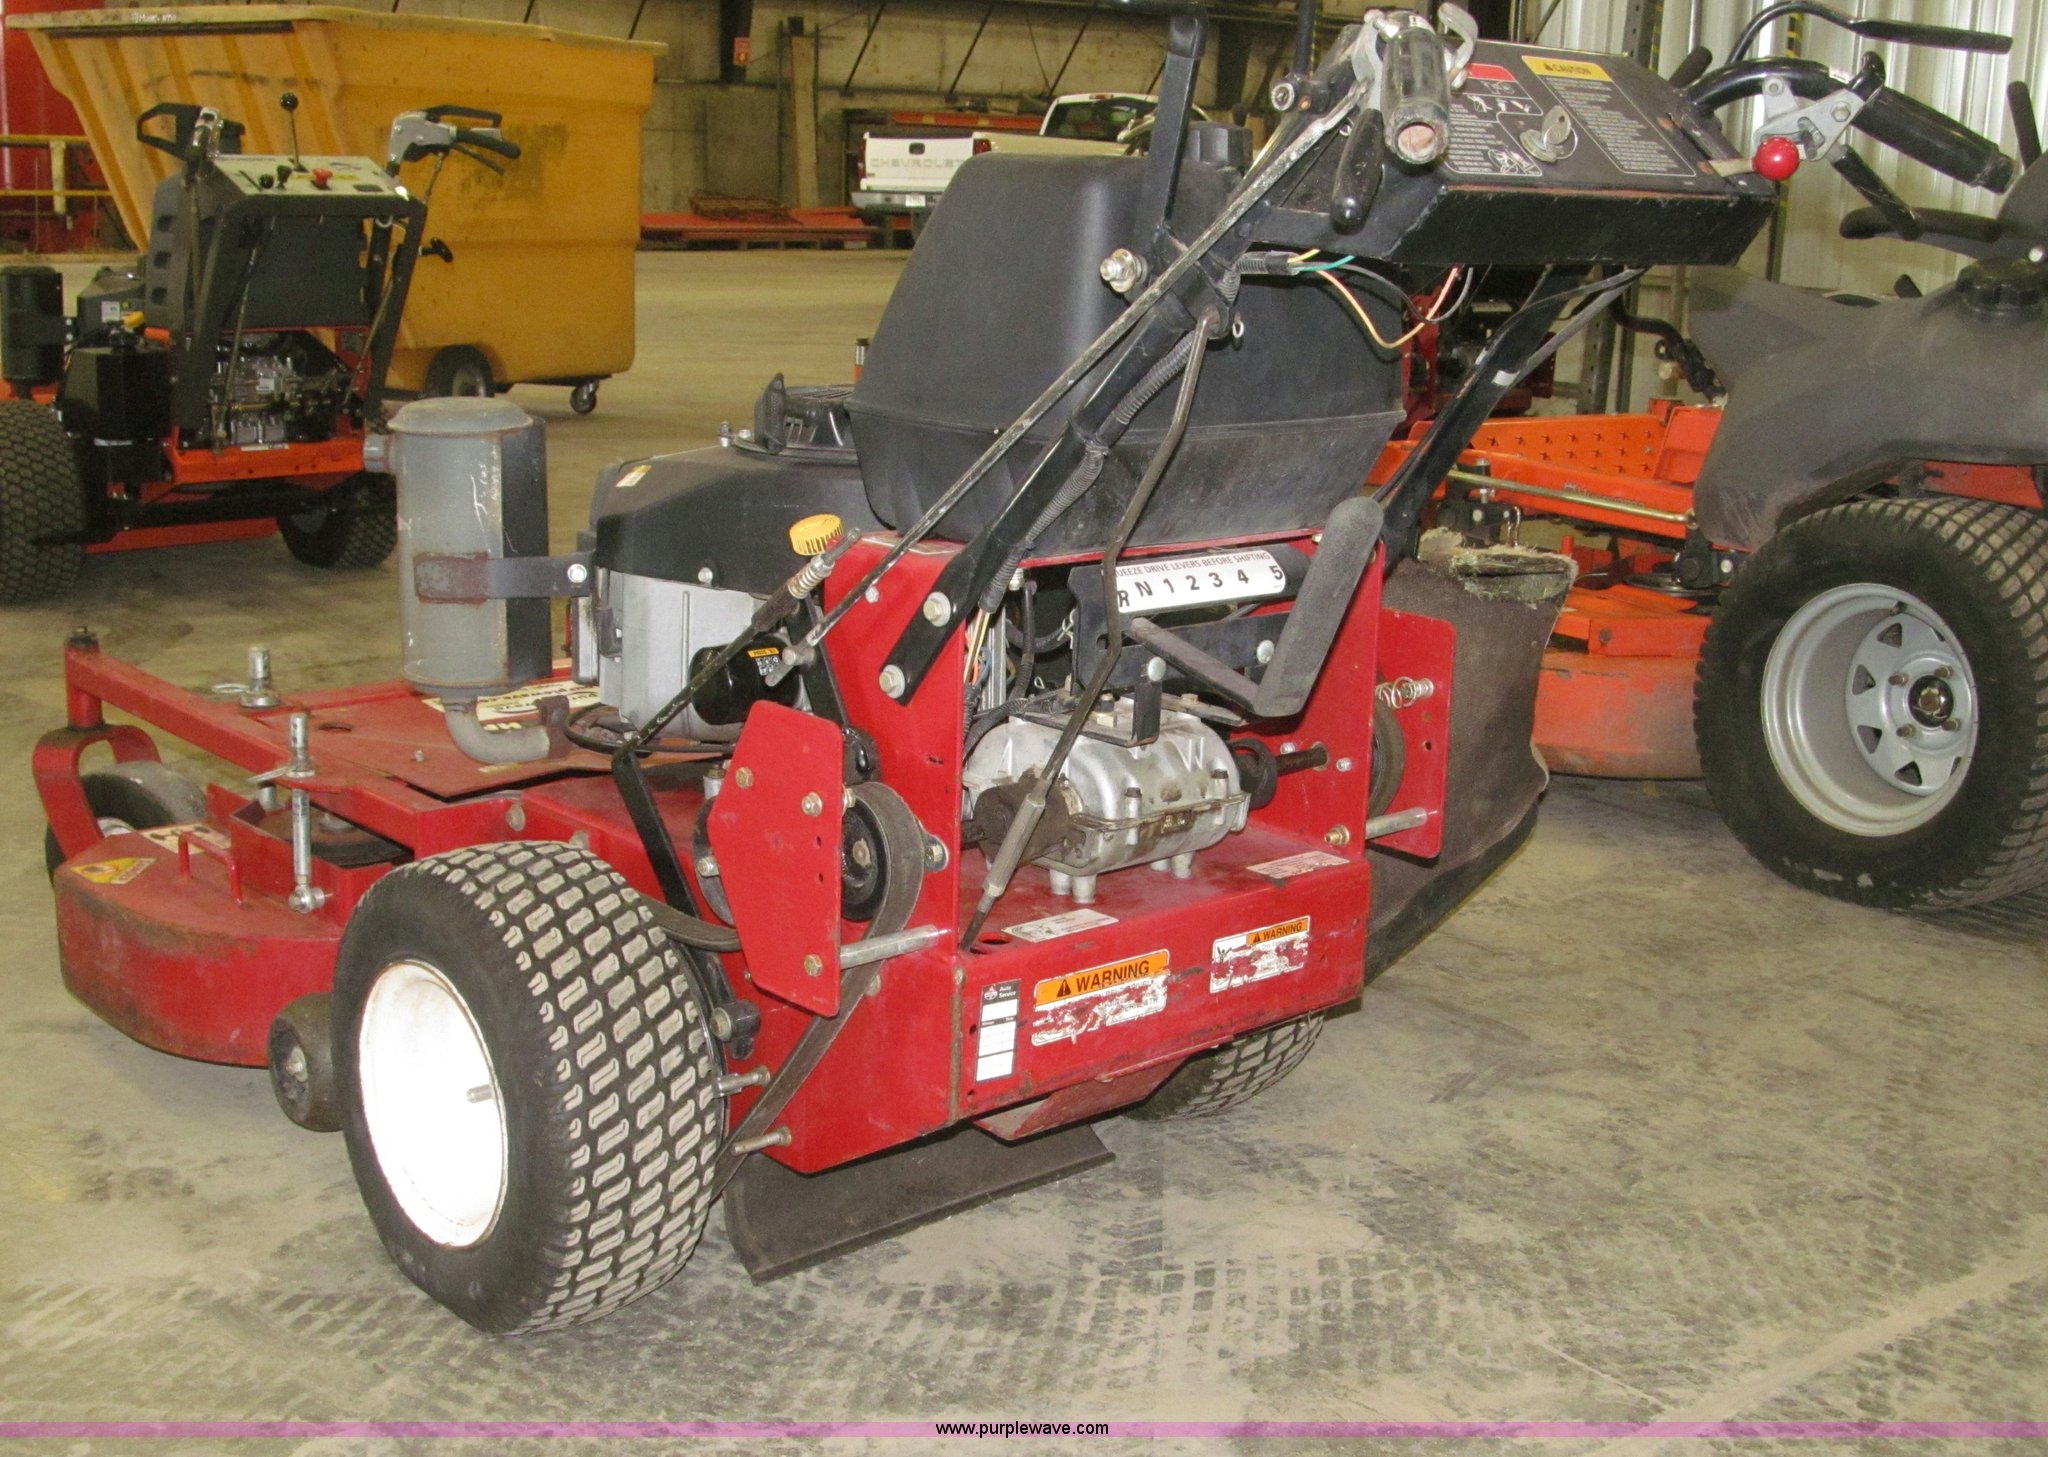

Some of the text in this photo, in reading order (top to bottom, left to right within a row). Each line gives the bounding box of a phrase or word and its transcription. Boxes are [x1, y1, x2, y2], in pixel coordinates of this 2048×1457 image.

[1144, 563, 1170, 573] DRIVE
[1171, 560, 1201, 570] LEVERS
[1202, 556, 1233, 567] BEFORE
[1233, 552, 1270, 562] SHIFTING
[1117, 565, 1283, 607] R N 1 2 3 4 5
[1263, 922, 1302, 939] WARNING
[1076, 960, 1149, 992] WARNING
